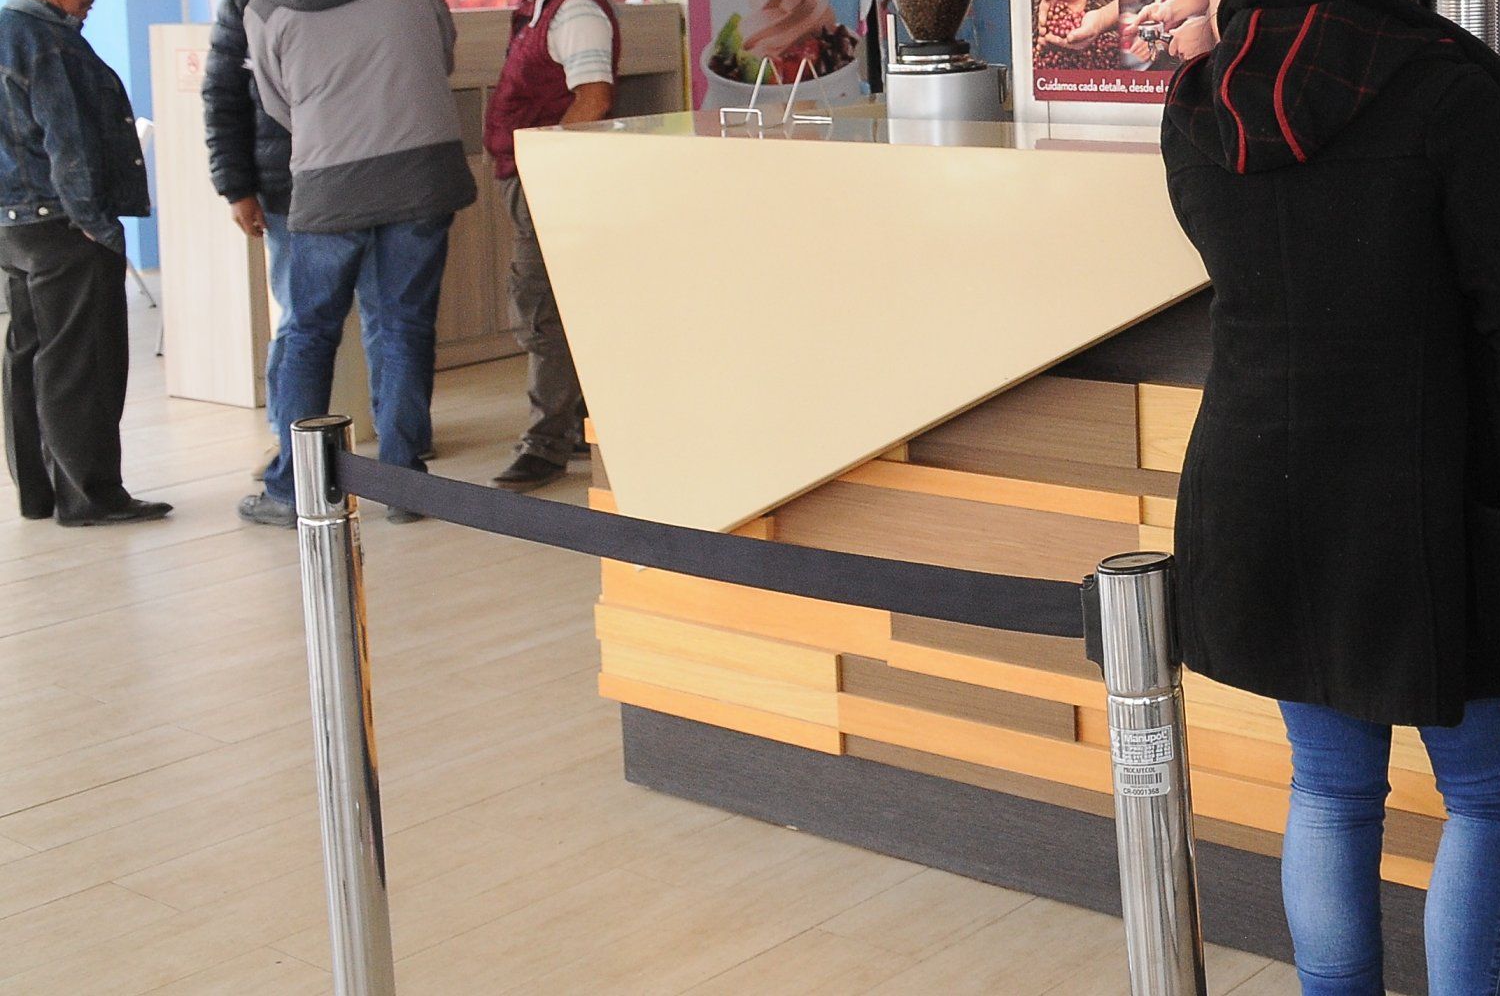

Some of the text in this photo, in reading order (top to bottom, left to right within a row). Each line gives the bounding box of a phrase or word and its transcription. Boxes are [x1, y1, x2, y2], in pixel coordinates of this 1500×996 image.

[1036, 77, 1164, 94] Cuidamos cada detalle, desde el
